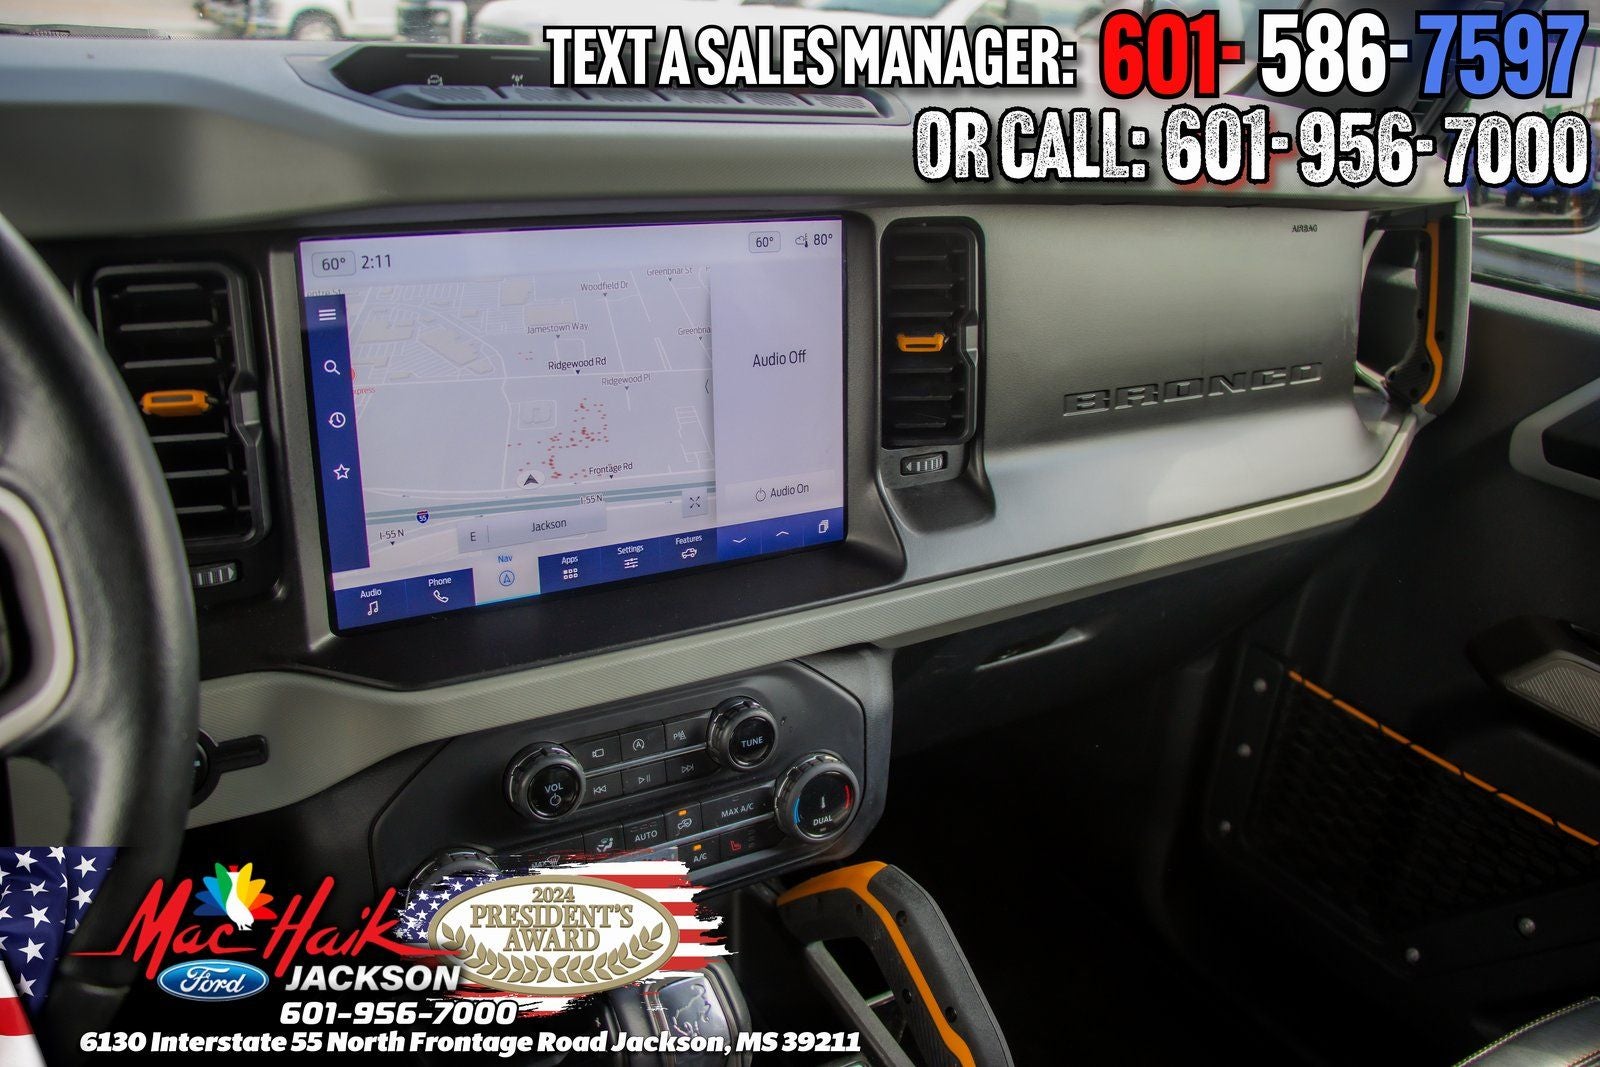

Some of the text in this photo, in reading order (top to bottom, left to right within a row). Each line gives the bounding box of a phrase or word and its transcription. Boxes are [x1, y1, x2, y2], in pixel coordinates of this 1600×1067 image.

[1291, 224, 1318, 232] AIRBAG
[755, 233, 833, 248] 60° 80°
[321, 254, 392, 271] 60° 2:11
[685, 266, 692, 274] St
[580, 280, 629, 291] Woodfield Dr
[527, 322, 588, 335] Jamestown Way
[548, 356, 607, 371] Ridgewood Rd
[752, 349, 807, 368] Audio Off
[601, 375, 643, 386] Ridgewood
[1063, 362, 1322, 417] BRONCO
[588, 461, 633, 475] Frontage Rd
[770, 483, 810, 498] Audio On
[596, 494, 604, 502] N
[531, 518, 567, 533] Jackson
[379, 529, 405, 540] I-55 N
[470, 531, 477, 542] E
[675, 534, 703, 545] Features
[617, 544, 644, 556] Settings
[498, 554, 513, 563] Nav
[561, 554, 579, 565] Apps
[428, 576, 452, 587] Phone
[360, 588, 382, 599] Audio
[741, 736, 763, 748] TUNE
[544, 782, 564, 793] VOL
[721, 802, 755, 818] MAX A/C
[813, 815, 833, 827] DUAL
[634, 829, 658, 843] AUTO
[693, 852, 708, 863] A/C
